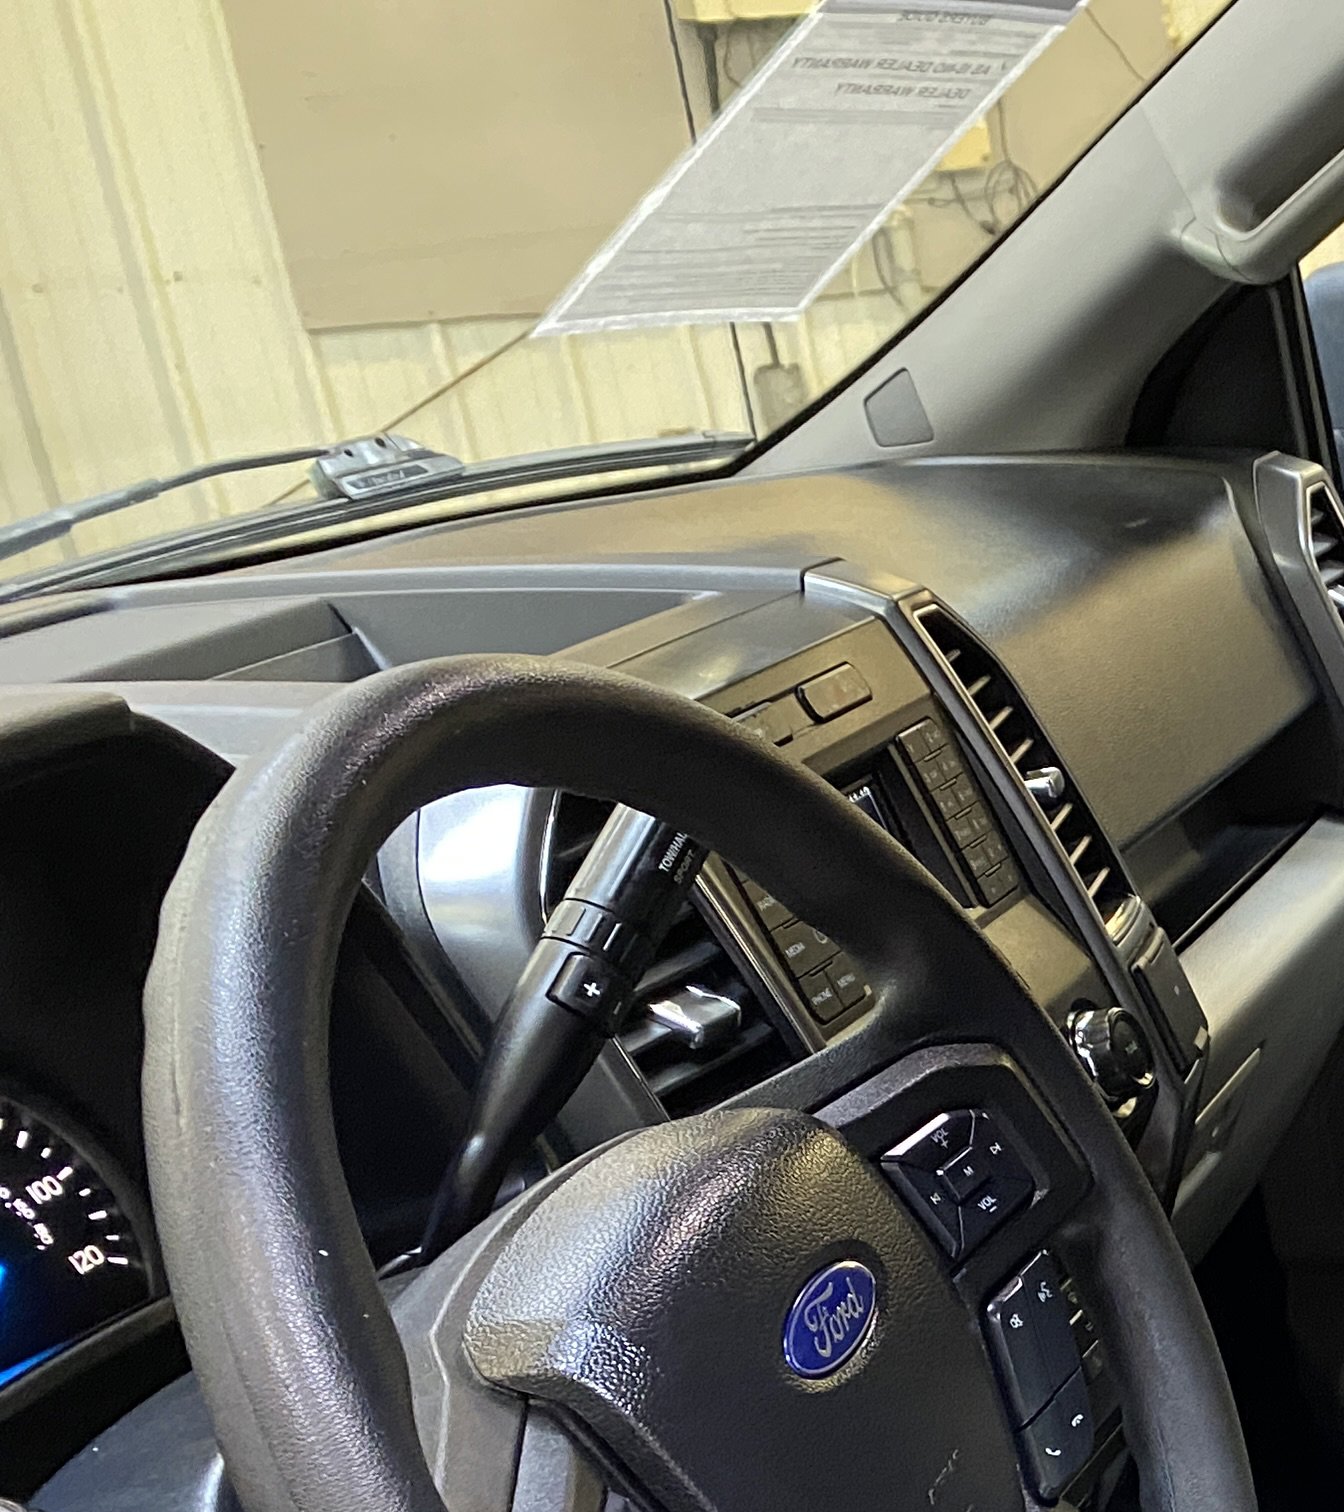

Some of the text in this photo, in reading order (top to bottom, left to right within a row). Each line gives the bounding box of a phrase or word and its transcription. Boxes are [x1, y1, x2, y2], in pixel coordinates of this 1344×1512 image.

[25, 1175, 63, 1205] 100
[977, 1195, 997, 1210] VOL
[67, 1244, 105, 1275] 120
[803, 1276, 865, 1358] Ford
